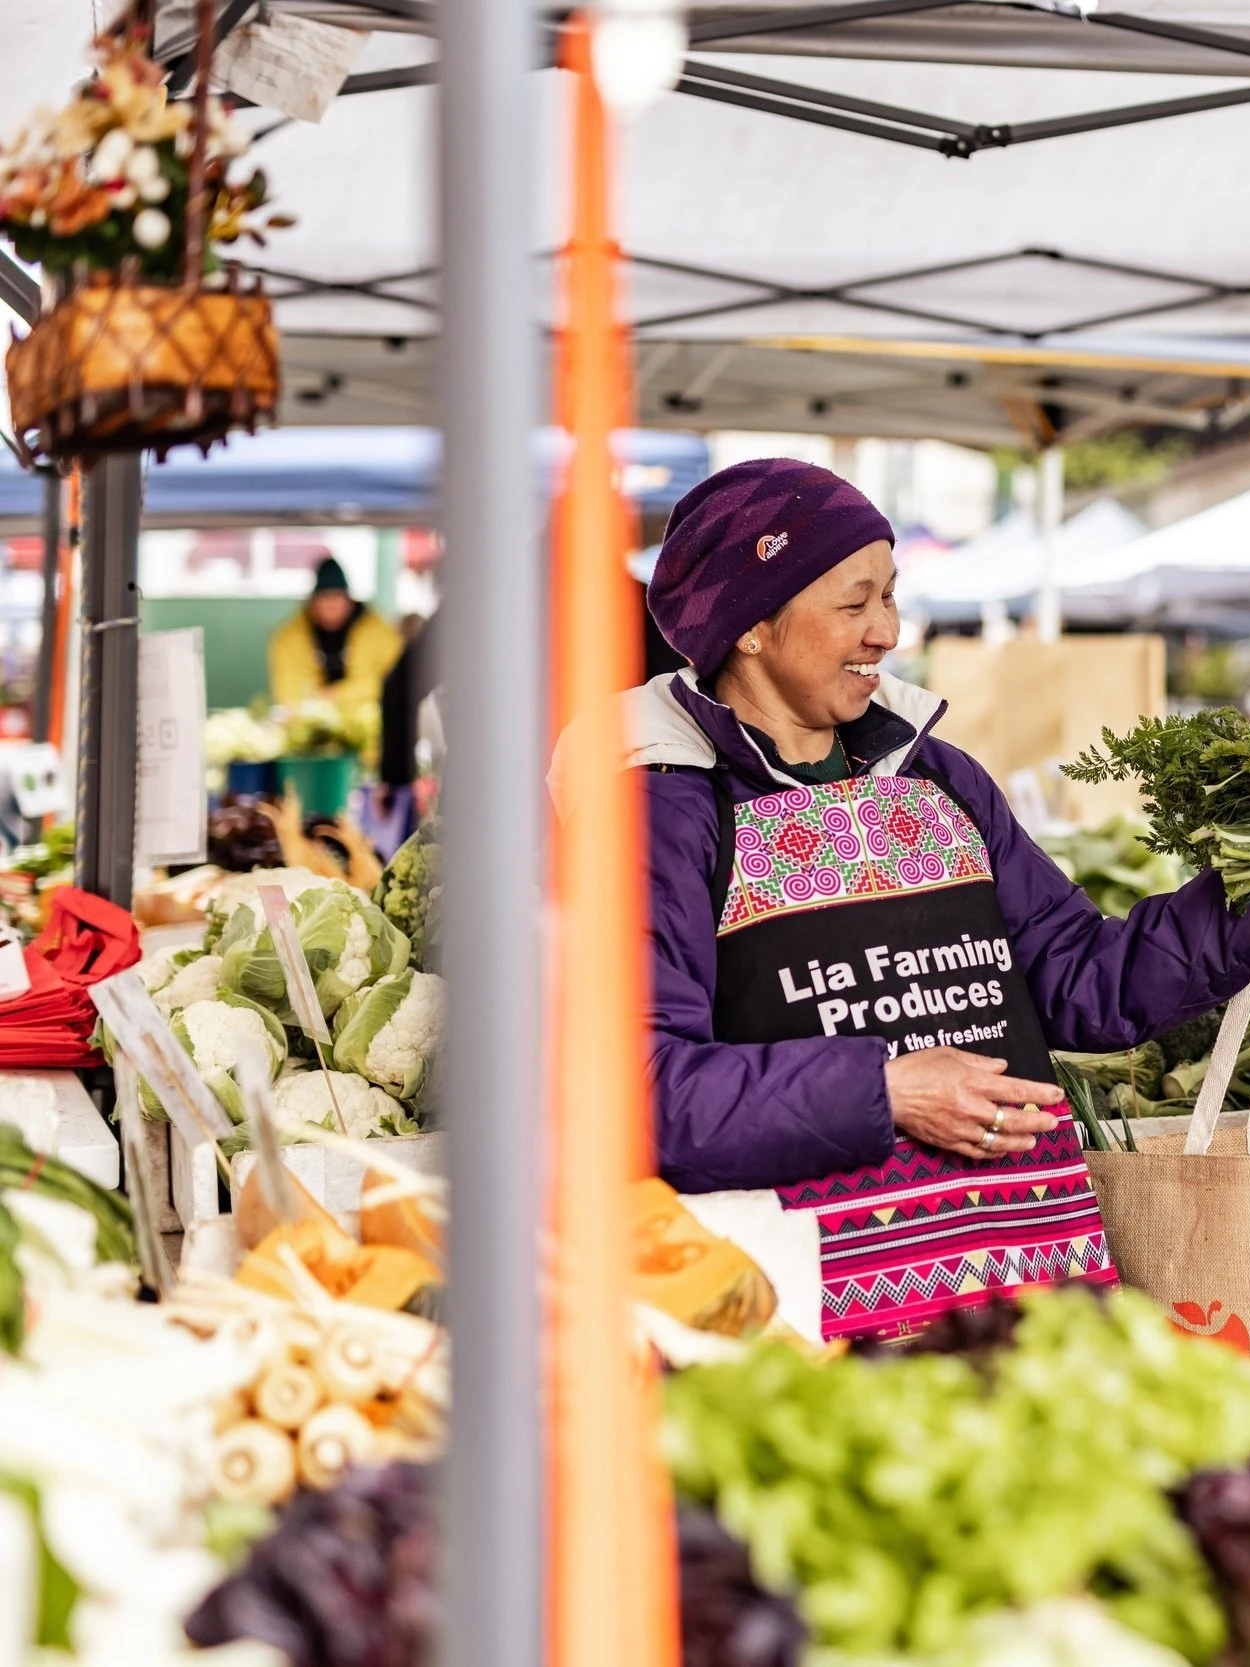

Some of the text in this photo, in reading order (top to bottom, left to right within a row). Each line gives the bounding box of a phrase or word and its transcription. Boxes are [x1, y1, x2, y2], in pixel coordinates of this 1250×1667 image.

[766, 532, 788, 549] Lowe
[766, 539, 789, 559] alpine
[778, 934, 1012, 1004] Lia Farming
[817, 979, 1004, 1037] Produces
[904, 1032, 936, 1052] the
